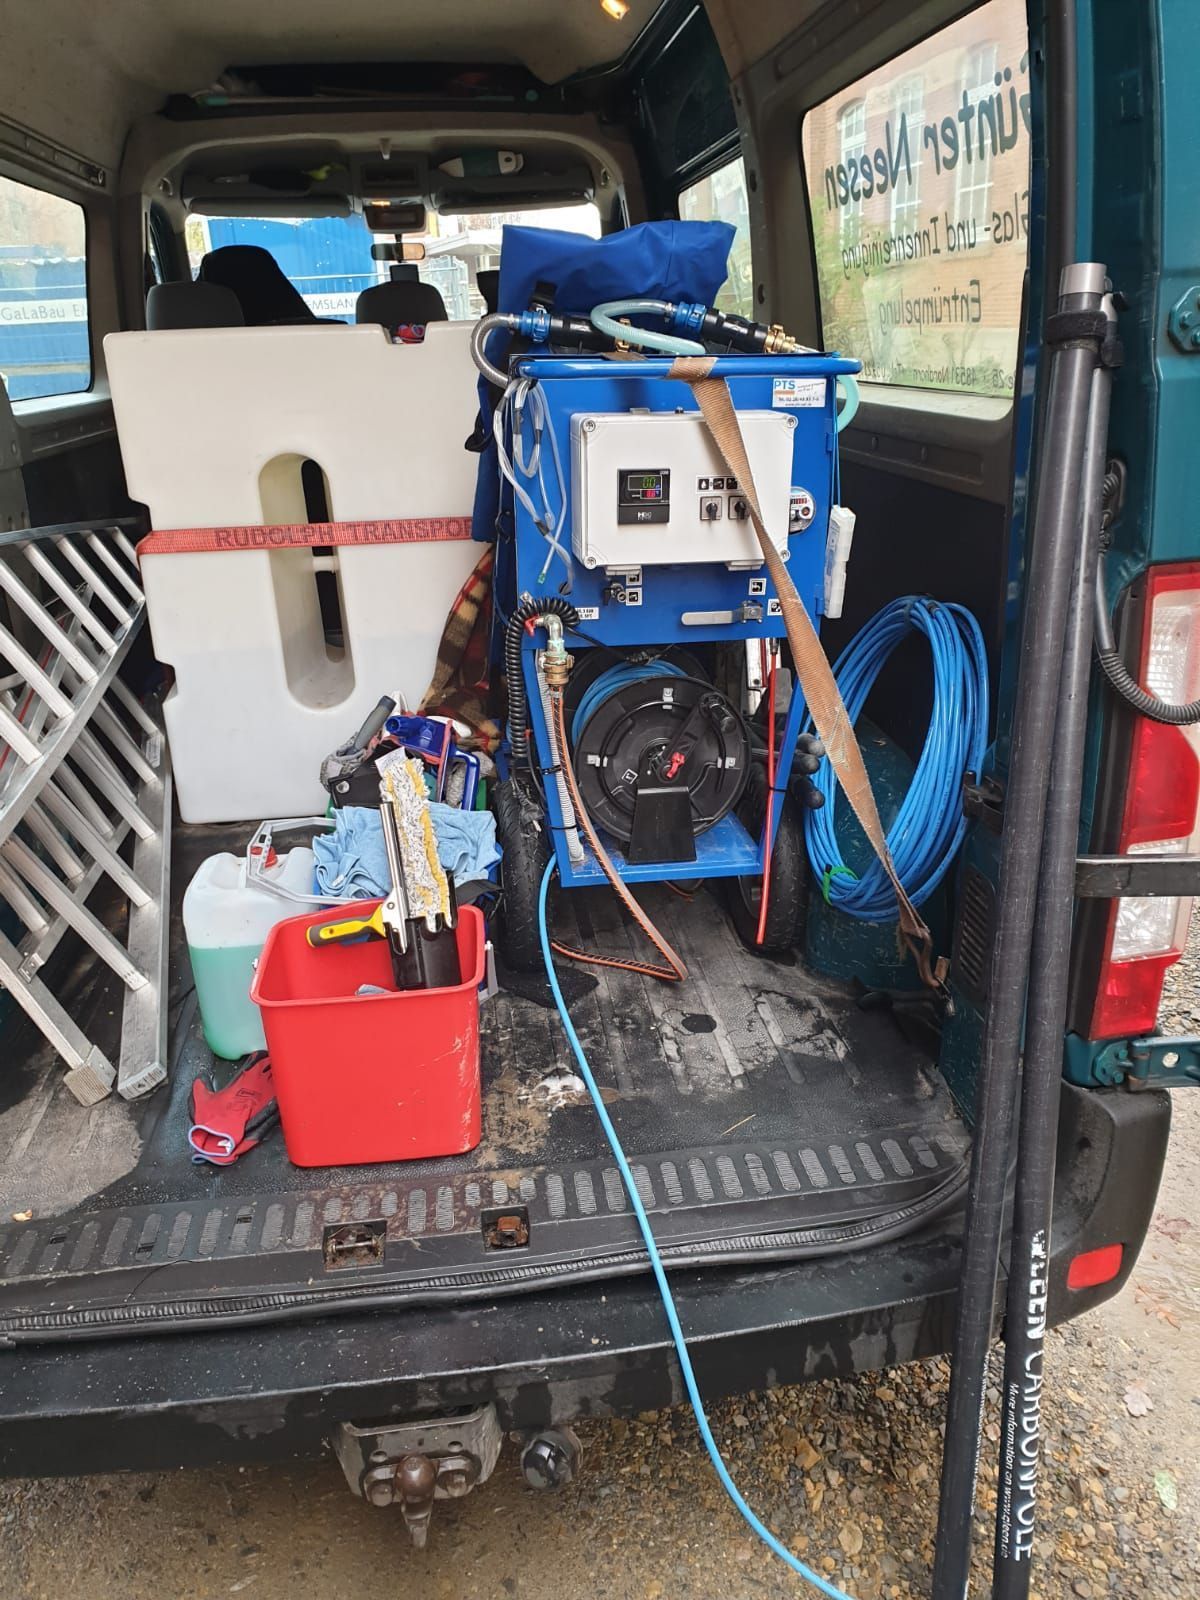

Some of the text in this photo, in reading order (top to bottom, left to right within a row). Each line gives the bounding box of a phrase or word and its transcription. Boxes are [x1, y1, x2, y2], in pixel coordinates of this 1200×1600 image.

[0, 303, 84, 321] GaLaBau E
[305, 298, 355, 311] MSLAN
[774, 380, 796, 390] PTS
[214, 523, 334, 548] RUDOLPH
[1008, 1383, 1019, 1409] More
